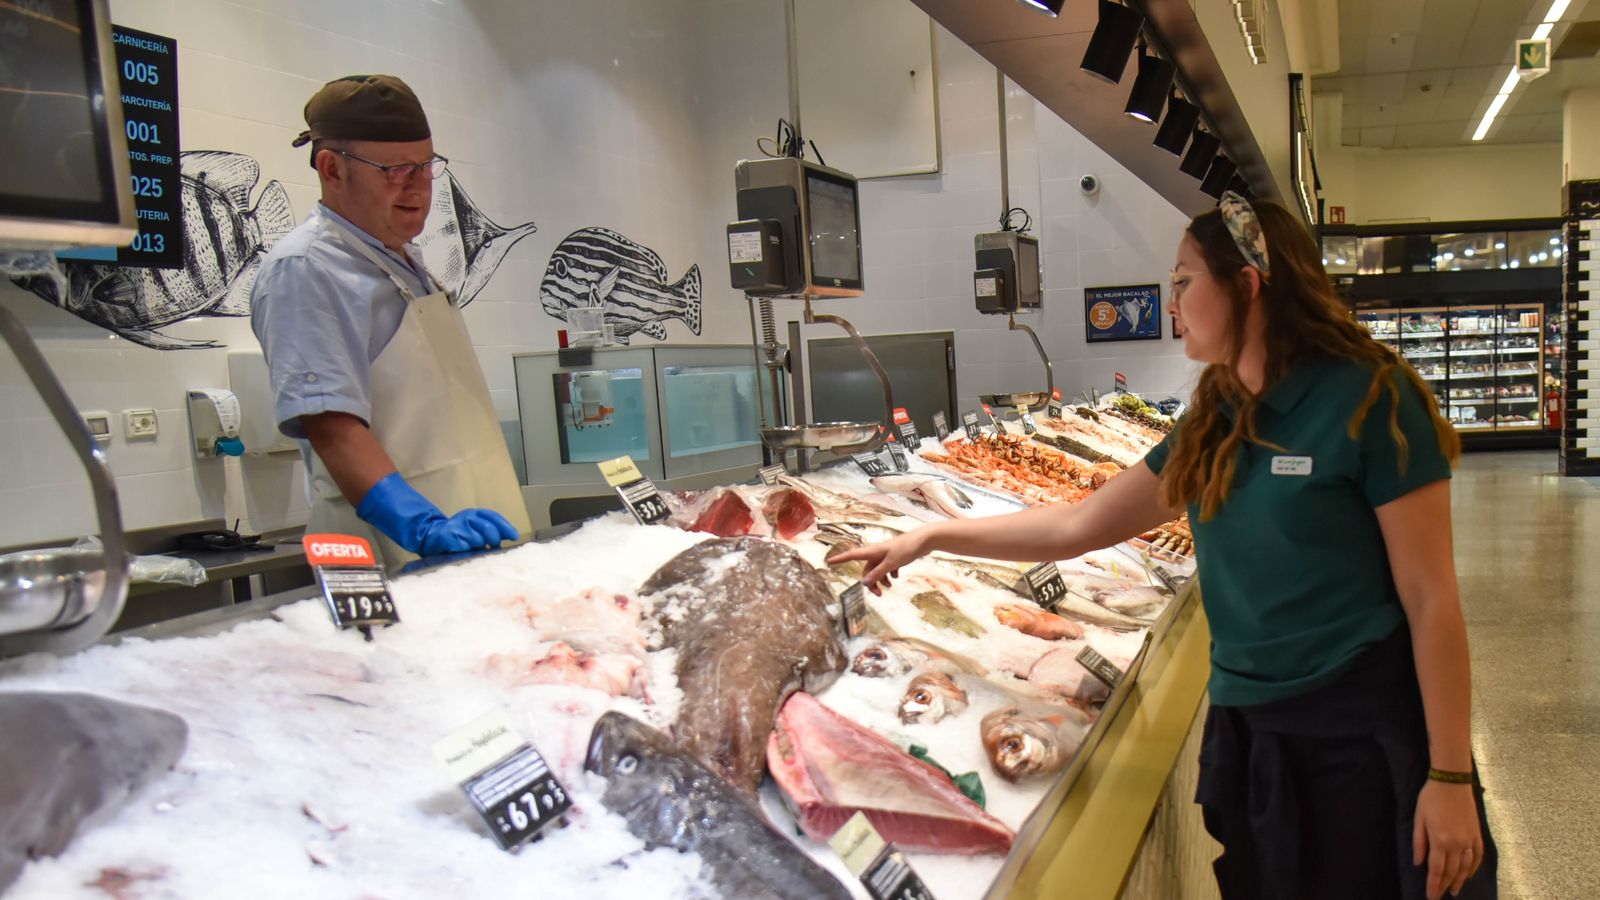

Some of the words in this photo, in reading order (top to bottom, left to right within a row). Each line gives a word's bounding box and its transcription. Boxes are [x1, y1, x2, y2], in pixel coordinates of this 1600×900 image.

[112, 33, 168, 54] CARNICERÍA
[124, 60, 159, 85] 005
[126, 120, 161, 144] 001
[151, 155, 173, 165] PREP.
[131, 175, 163, 198] 025
[132, 233, 165, 252] 013
[310, 542, 369, 559] OFERTA
